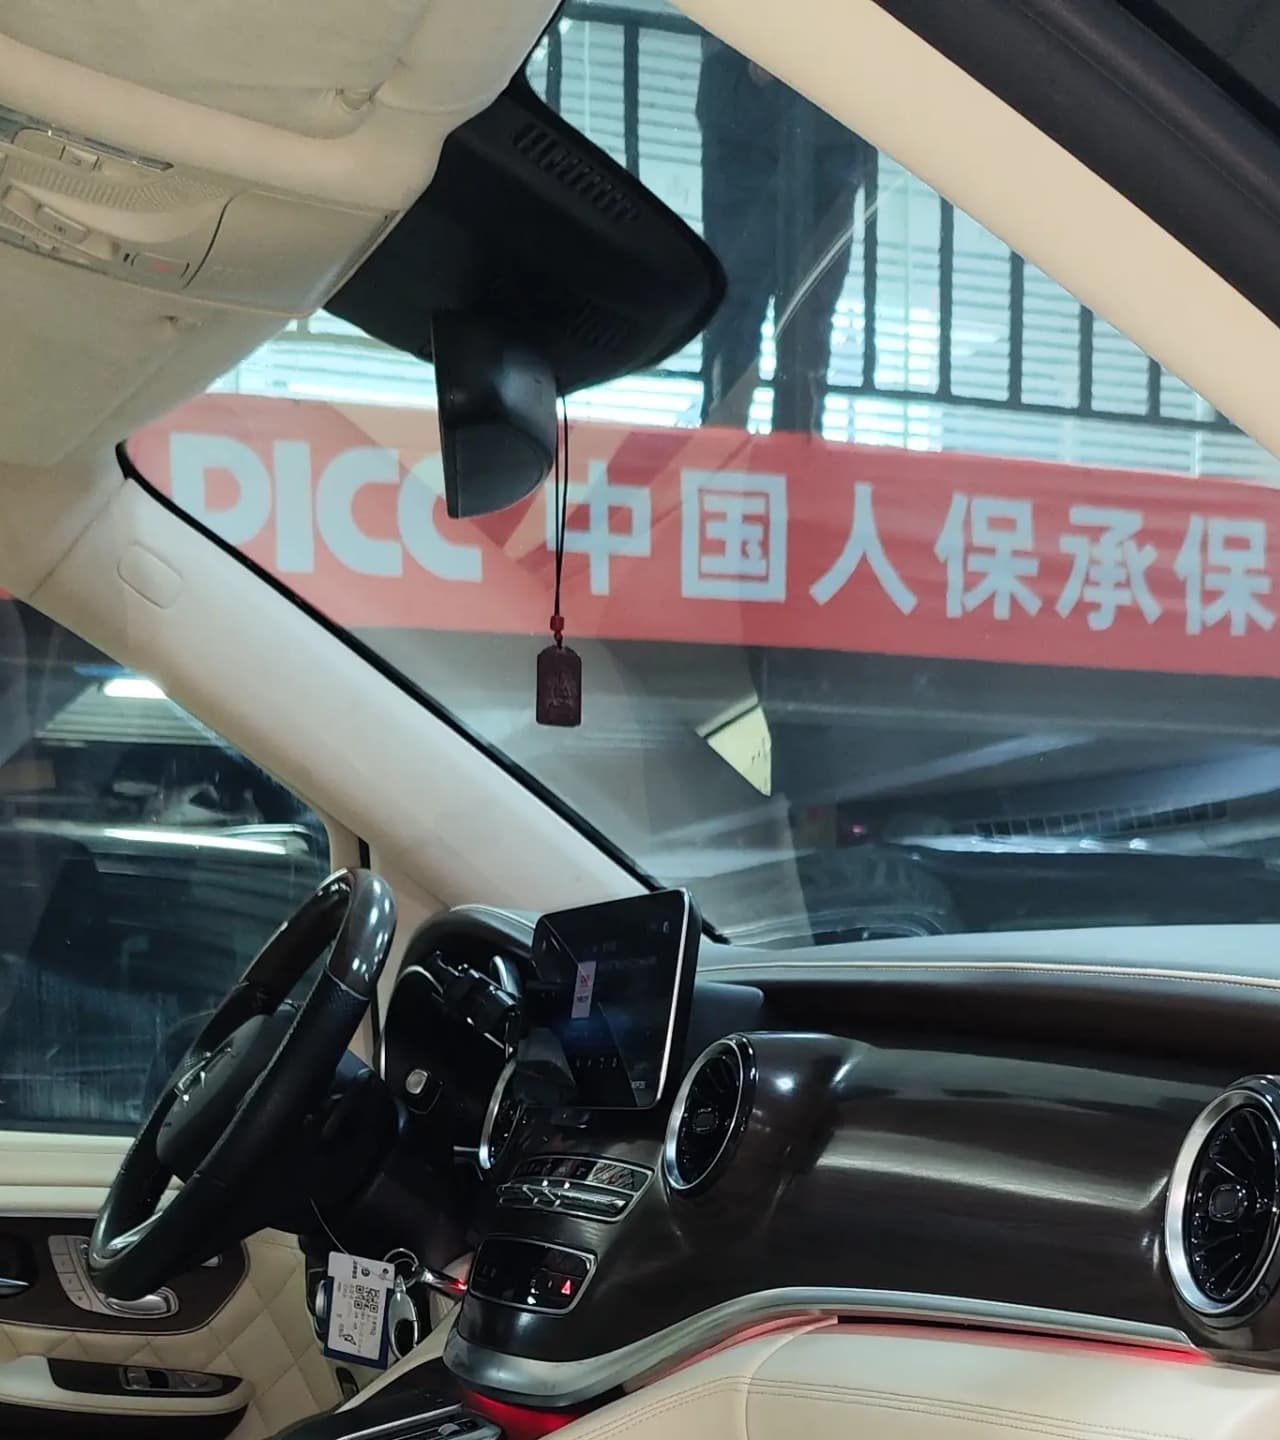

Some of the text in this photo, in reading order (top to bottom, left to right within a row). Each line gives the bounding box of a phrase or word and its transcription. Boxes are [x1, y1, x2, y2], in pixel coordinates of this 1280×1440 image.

[545, 461, 1277, 636] 中国人保承保
